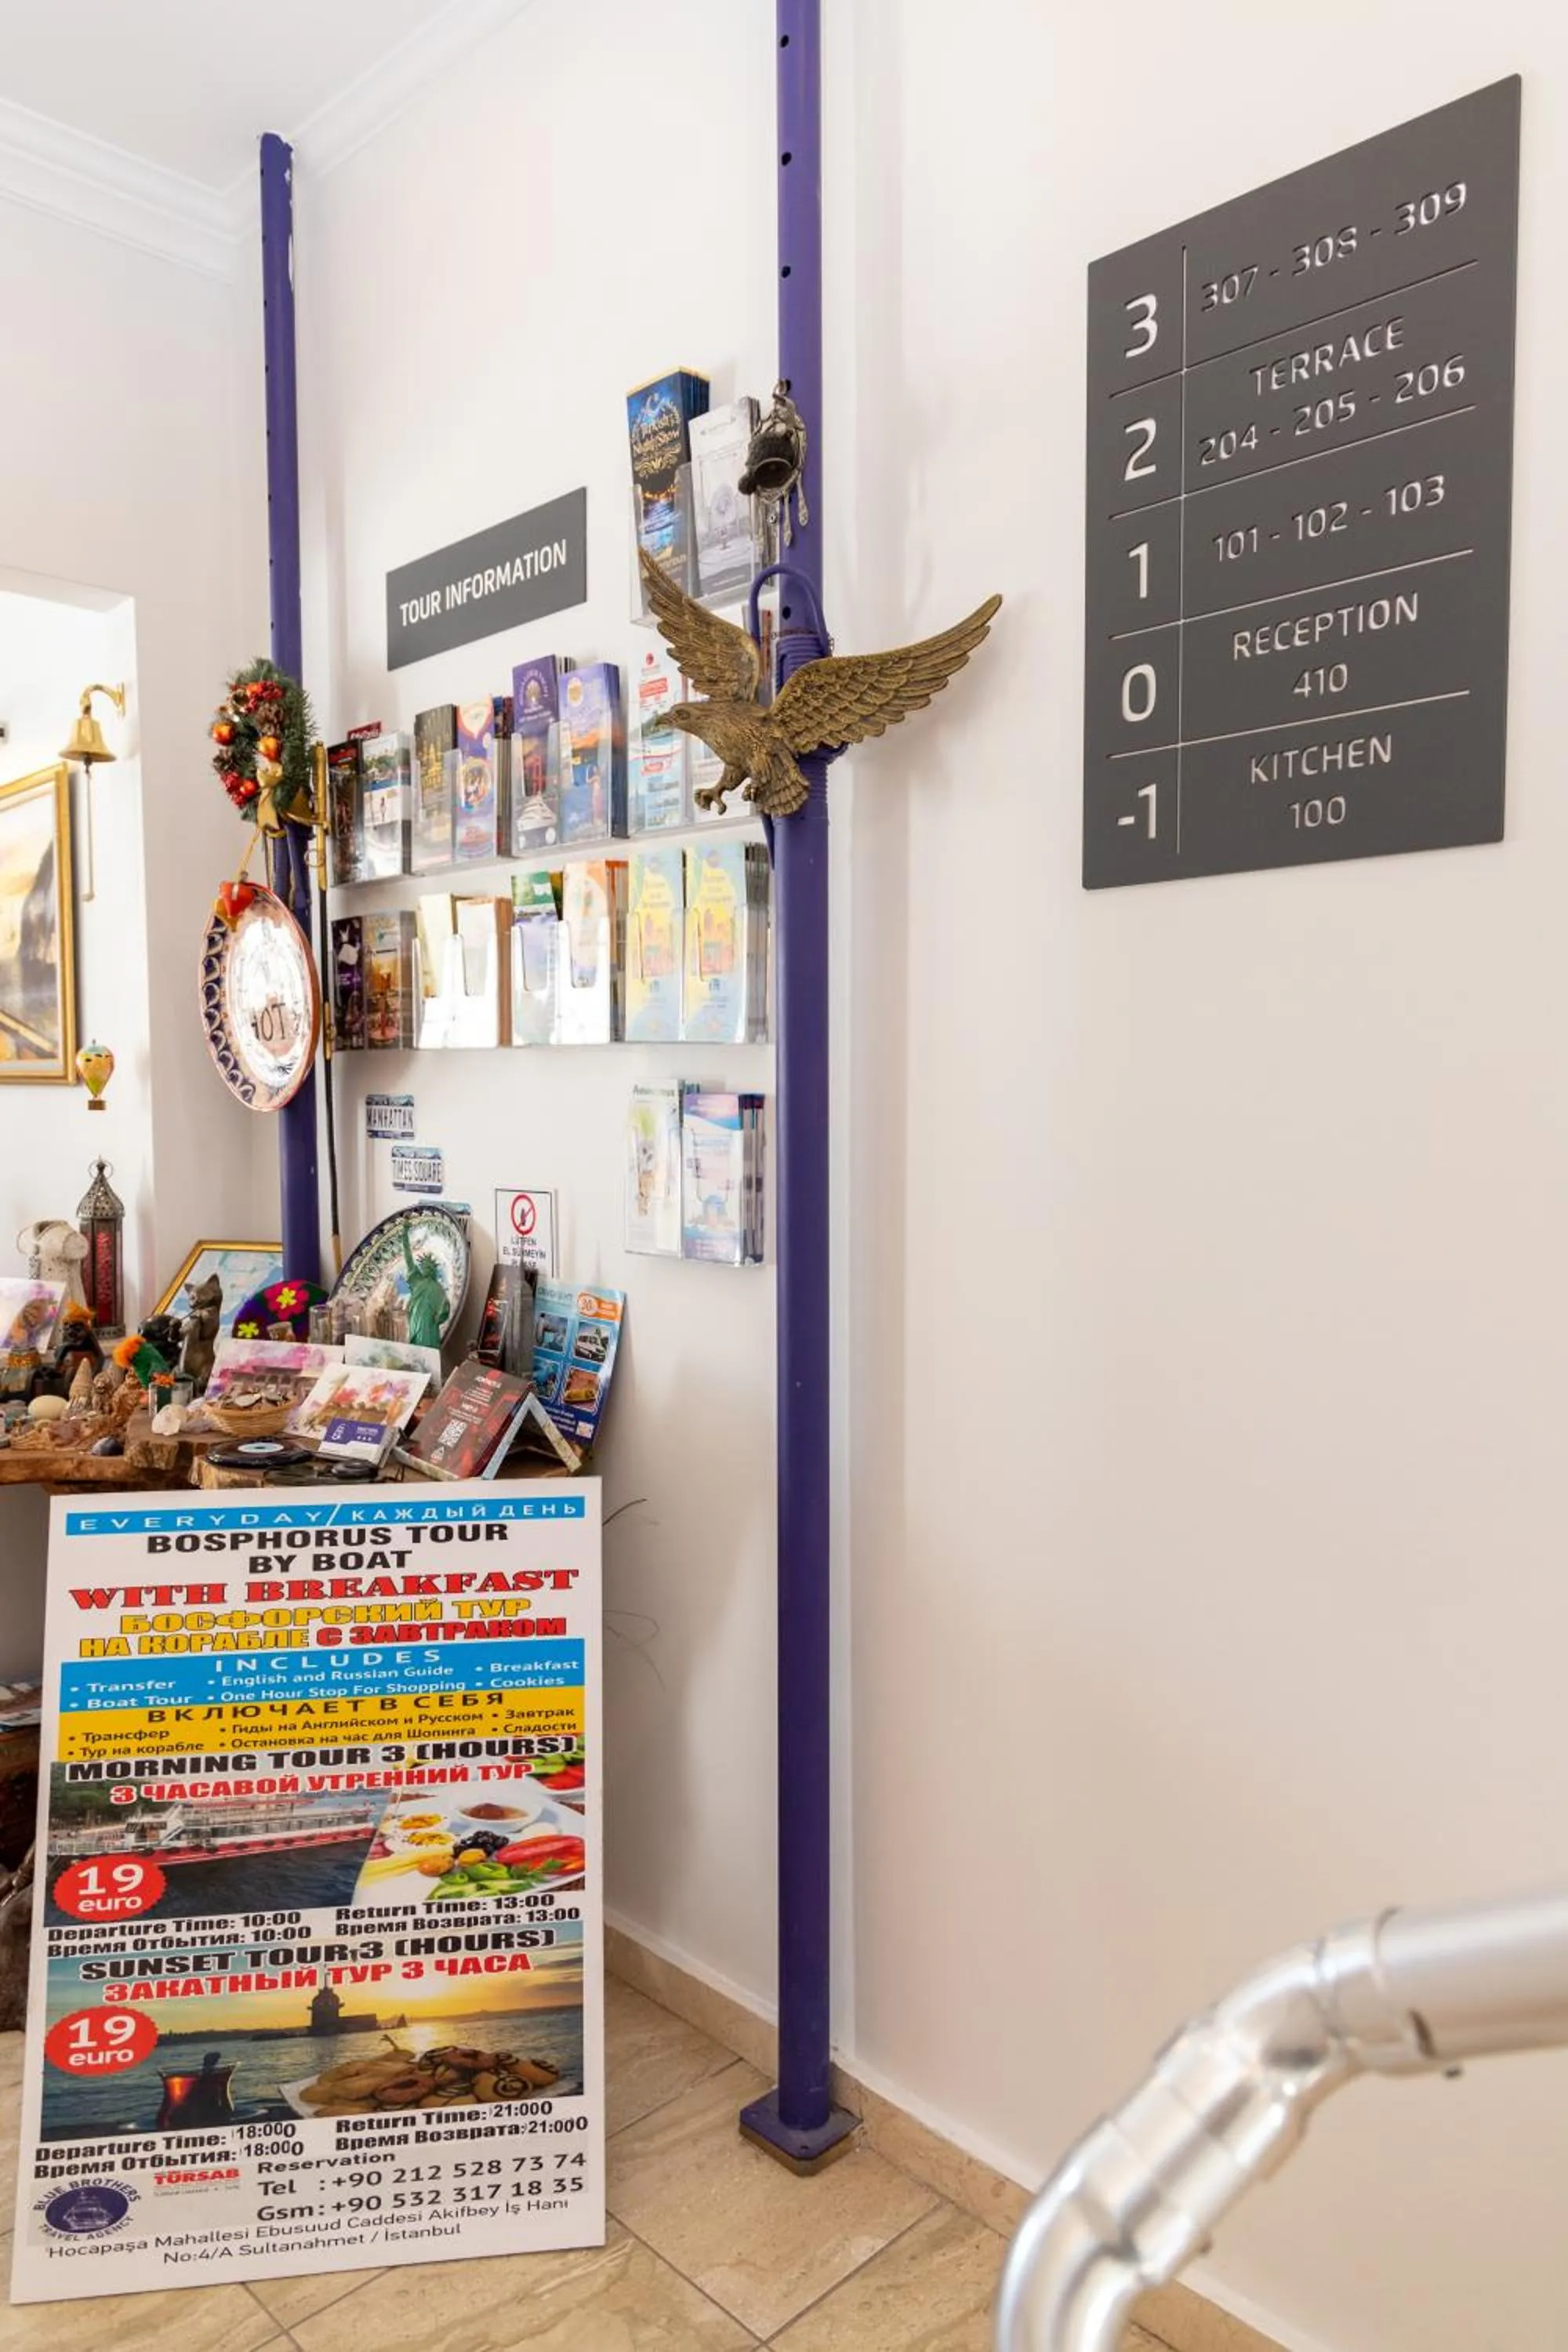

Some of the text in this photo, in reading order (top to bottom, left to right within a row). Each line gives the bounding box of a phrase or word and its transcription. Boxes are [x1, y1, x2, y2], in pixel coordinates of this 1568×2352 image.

[1200, 180, 1467, 313] 307 308 309
[1124, 293, 1158, 359] 3
[1249, 316, 1406, 397] TERRACE
[1198, 354, 1465, 466] 204 205 206
[1123, 418, 1157, 481] 2
[1212, 475, 1446, 562] 101 102 103
[400, 539, 568, 627] TOUR INFORMATION
[1127, 542, 1149, 600] 1
[1232, 592, 1419, 661] RECEPTION
[1121, 664, 1157, 723] 0
[1292, 663, 1348, 699] 410
[1250, 734, 1392, 785] KITCHEN
[1117, 782, 1157, 840] -1
[1289, 795, 1347, 829] 100
[366, 1107, 414, 1130] MANHATTAN
[414, 1160, 442, 1183] SQUARE
[499, 1502, 577, 1519] ДЕНЬ
[147, 1523, 508, 1554] BOSPHORUS TOUR
[249, 1550, 412, 1574] BY BOAT
[68, 1569, 579, 1610] WITH BREAKFAST
[120, 1597, 532, 1635] БОСФОРСКИЙ ТУР
[79, 1617, 567, 1658] НА КОРАБЛЕ С ЗАВТРАКОМ
[216, 1649, 441, 1673] INCLUDES
[221, 1664, 455, 1688] English and Russian Guide
[490, 1659, 579, 1673] Breakfast
[87, 1679, 176, 1693] Transfer
[220, 1679, 466, 1702] One Hour Stop For Shopping
[490, 1675, 565, 1689] Cookies
[87, 1694, 194, 1709] Boat Tour
[147, 1693, 504, 1723] ВКЛЮЧАЕТ В СЕБЯ
[504, 1708, 575, 1719] Завтрак
[82, 1728, 170, 1744] Трансфер
[230, 1726, 476, 1749] Остановка на час для Шопинга
[232, 1712, 484, 1735] Гиды на Английском и Русском
[503, 1721, 577, 1734] Сладости
[67, 1735, 576, 1781] MORNING TOUR 3 (HOURS)
[79, 1741, 205, 1759] Тур на корабле
[143, 1773, 299, 1802] ЧАСАВОЙ
[307, 1764, 469, 1791] УТРЕННИЙ
[477, 1763, 533, 1780] ТУР
[78, 1863, 144, 1895] 19
[78, 1896, 143, 1912] euro
[336, 1893, 554, 1920] Return Time: 13:00
[48, 1911, 302, 1942] Departure Time: 10:00
[336, 1907, 580, 1937] Время Возврата: 13:00
[47, 1926, 312, 1958] Время Отбытия: 10:00
[81, 1929, 554, 1981] SUNSET TOUR 3 (HOURS)
[104, 1965, 318, 2002] ЗАКАТНЫЙ
[327, 1963, 393, 1985] ТУР
[434, 1953, 532, 1976] ЧАСА
[68, 2015, 136, 2049] 19
[68, 2049, 134, 2067] euro
[336, 2117, 417, 2133] Return
[422, 2110, 487, 2125] Time:
[35, 2140, 156, 2162] Departure
[162, 2132, 226, 2149] Time:
[336, 2133, 409, 2152] Время
[34, 2160, 115, 2180] Время
[122, 2150, 237, 2172] Отбытия:
[154, 2167, 240, 2186] TÜRSAB
[257, 2151, 396, 2174] Reservation
[257, 2178, 296, 2196] Tel
[392, 2165, 442, 2185] 212
[452, 2159, 502, 2179] 528
[512, 2155, 544, 2172] 73
[553, 2152, 587, 2169] 74
[33, 2184, 67, 2212] BLUE
[69, 2177, 142, 2203] BROTHERS
[392, 2190, 442, 2209] 532
[452, 2183, 502, 2203] 317
[511, 2180, 543, 2198] 18
[553, 2176, 584, 2194] 35
[49, 2240, 148, 2259] Hocapaşa
[154, 2227, 249, 2249] Mahallesi
[256, 2219, 341, 2238] Ebusuud
[347, 2212, 423, 2229] Caddesi
[428, 2204, 500, 2222] Akifbey
[505, 2198, 521, 2215] İş
[86, 2216, 135, 2241] AGENCY
[163, 2223, 461, 2265] No:4/A Sultanahmet İstanbul
